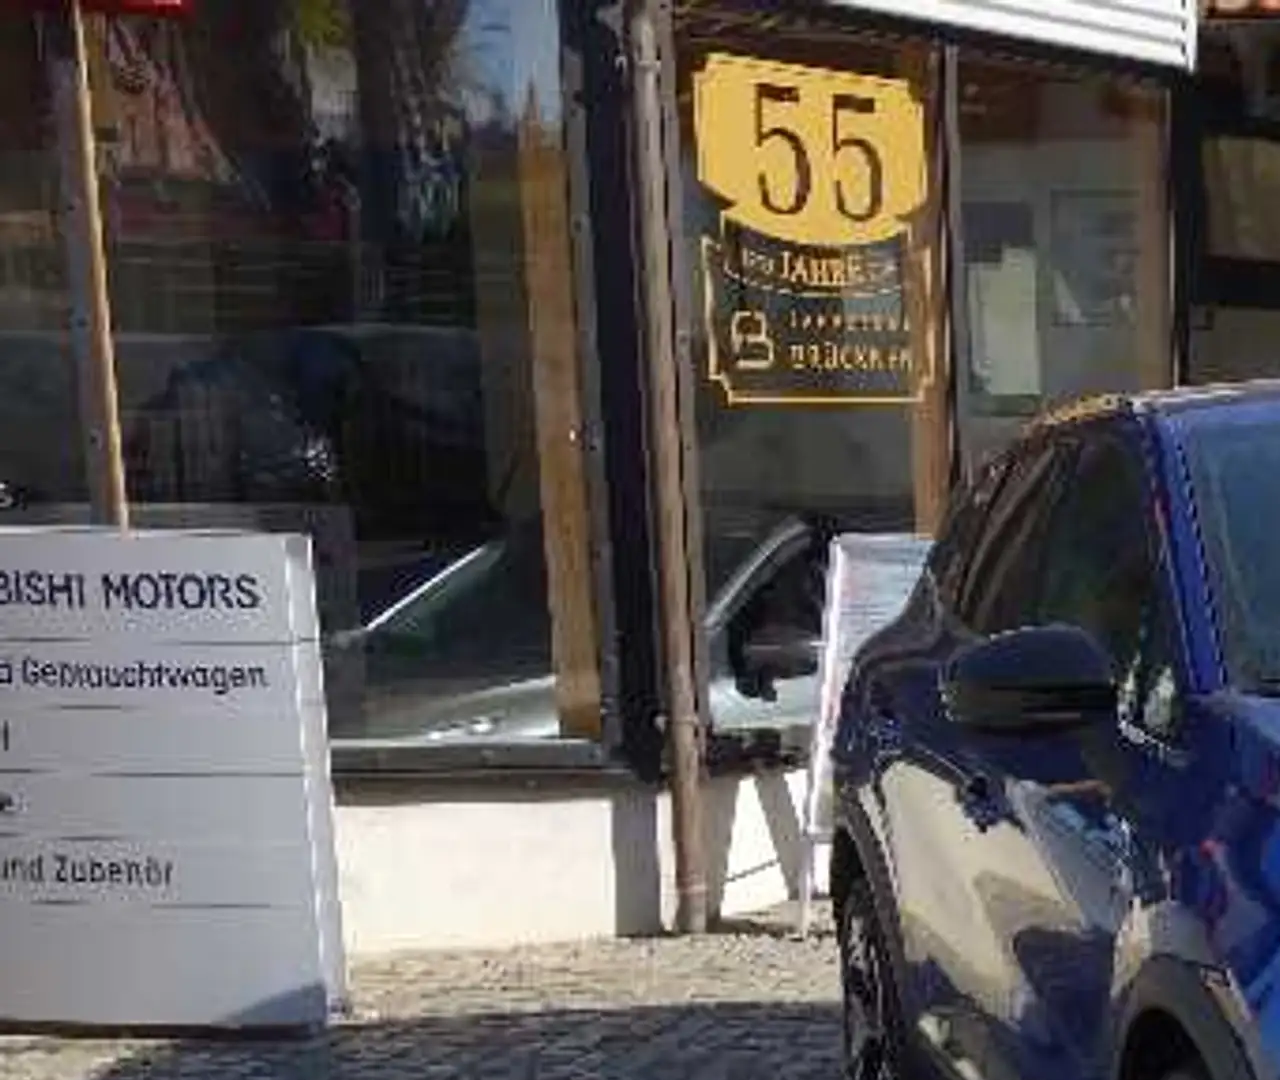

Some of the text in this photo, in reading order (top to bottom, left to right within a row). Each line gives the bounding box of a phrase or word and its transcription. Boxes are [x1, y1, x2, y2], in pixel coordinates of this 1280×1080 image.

[755, 82, 883, 222] 55
[781, 250, 865, 286] JAHRE
[102, 573, 260, 611] MOTORS
[22, 657, 268, 696] Gebrauchtwagen
[55, 852, 174, 887] Zubehör
